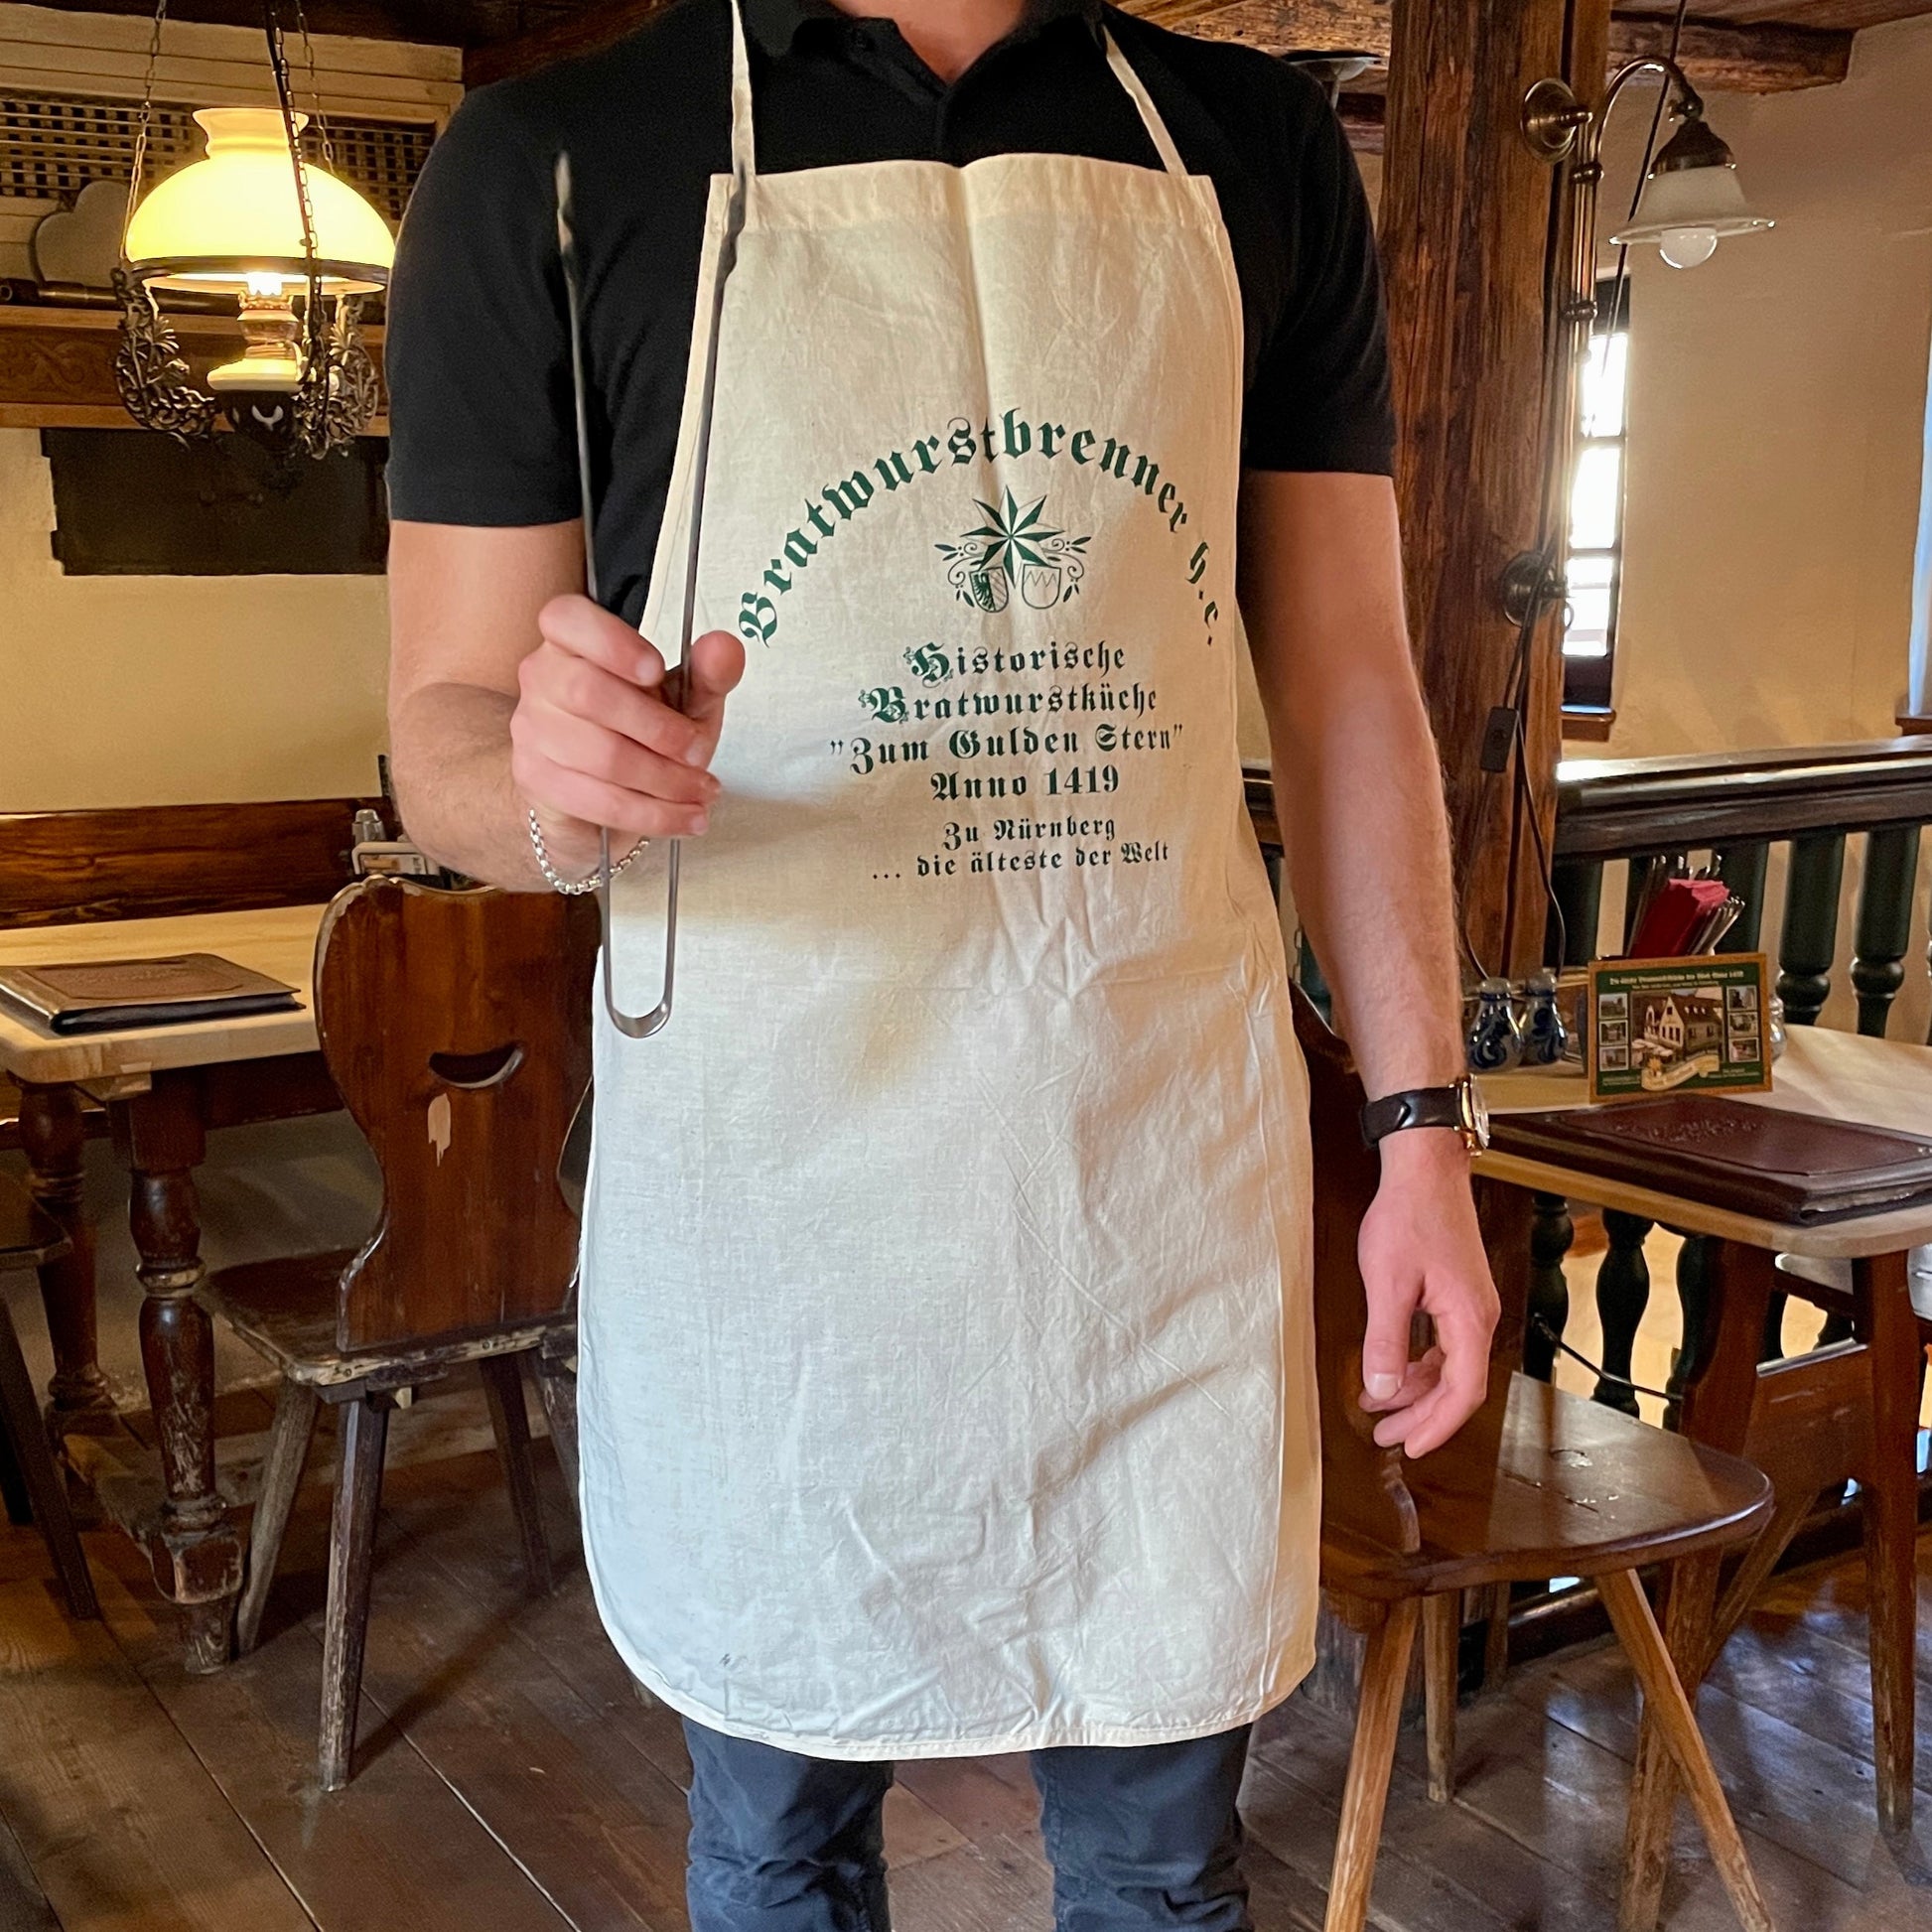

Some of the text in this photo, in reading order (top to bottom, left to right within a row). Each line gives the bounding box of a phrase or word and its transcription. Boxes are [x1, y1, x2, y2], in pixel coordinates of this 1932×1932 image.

[739, 407, 1187, 647] Bratwurstbrenner
[903, 640, 1126, 688] Historische
[858, 682, 1157, 724] Bratwurstküche
[948, 727, 1078, 759] Gulden
[930, 763, 1119, 801] Anno 1419
[943, 816, 1115, 851] Zu Nürnberg
[917, 854, 956, 878] die
[970, 851, 1063, 874] älteste
[1075, 847, 1112, 868] der
[1121, 840, 1170, 865] Welt
